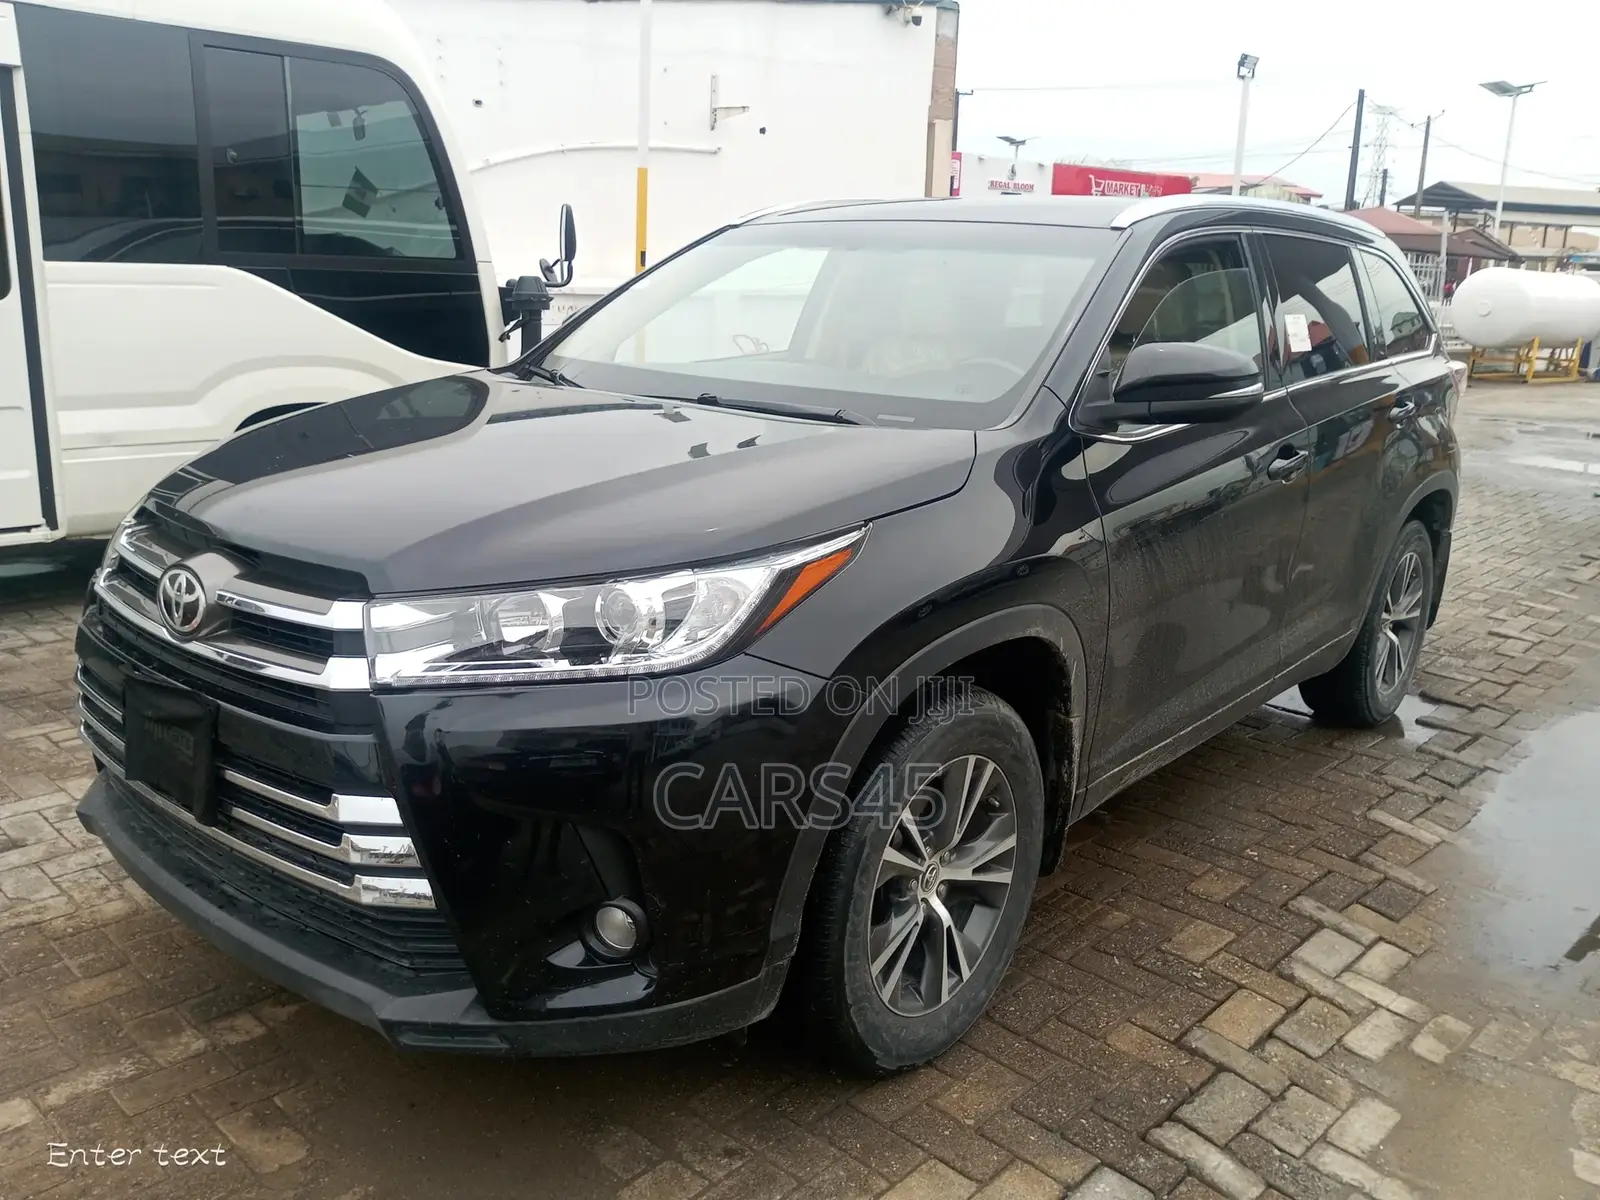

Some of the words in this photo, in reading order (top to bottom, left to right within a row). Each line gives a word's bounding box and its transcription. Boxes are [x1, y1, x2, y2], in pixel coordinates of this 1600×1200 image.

[990, 180, 1010, 189] REGAL
[1013, 182, 1034, 191] BLOOM
[1106, 181, 1140, 196] MARKET
